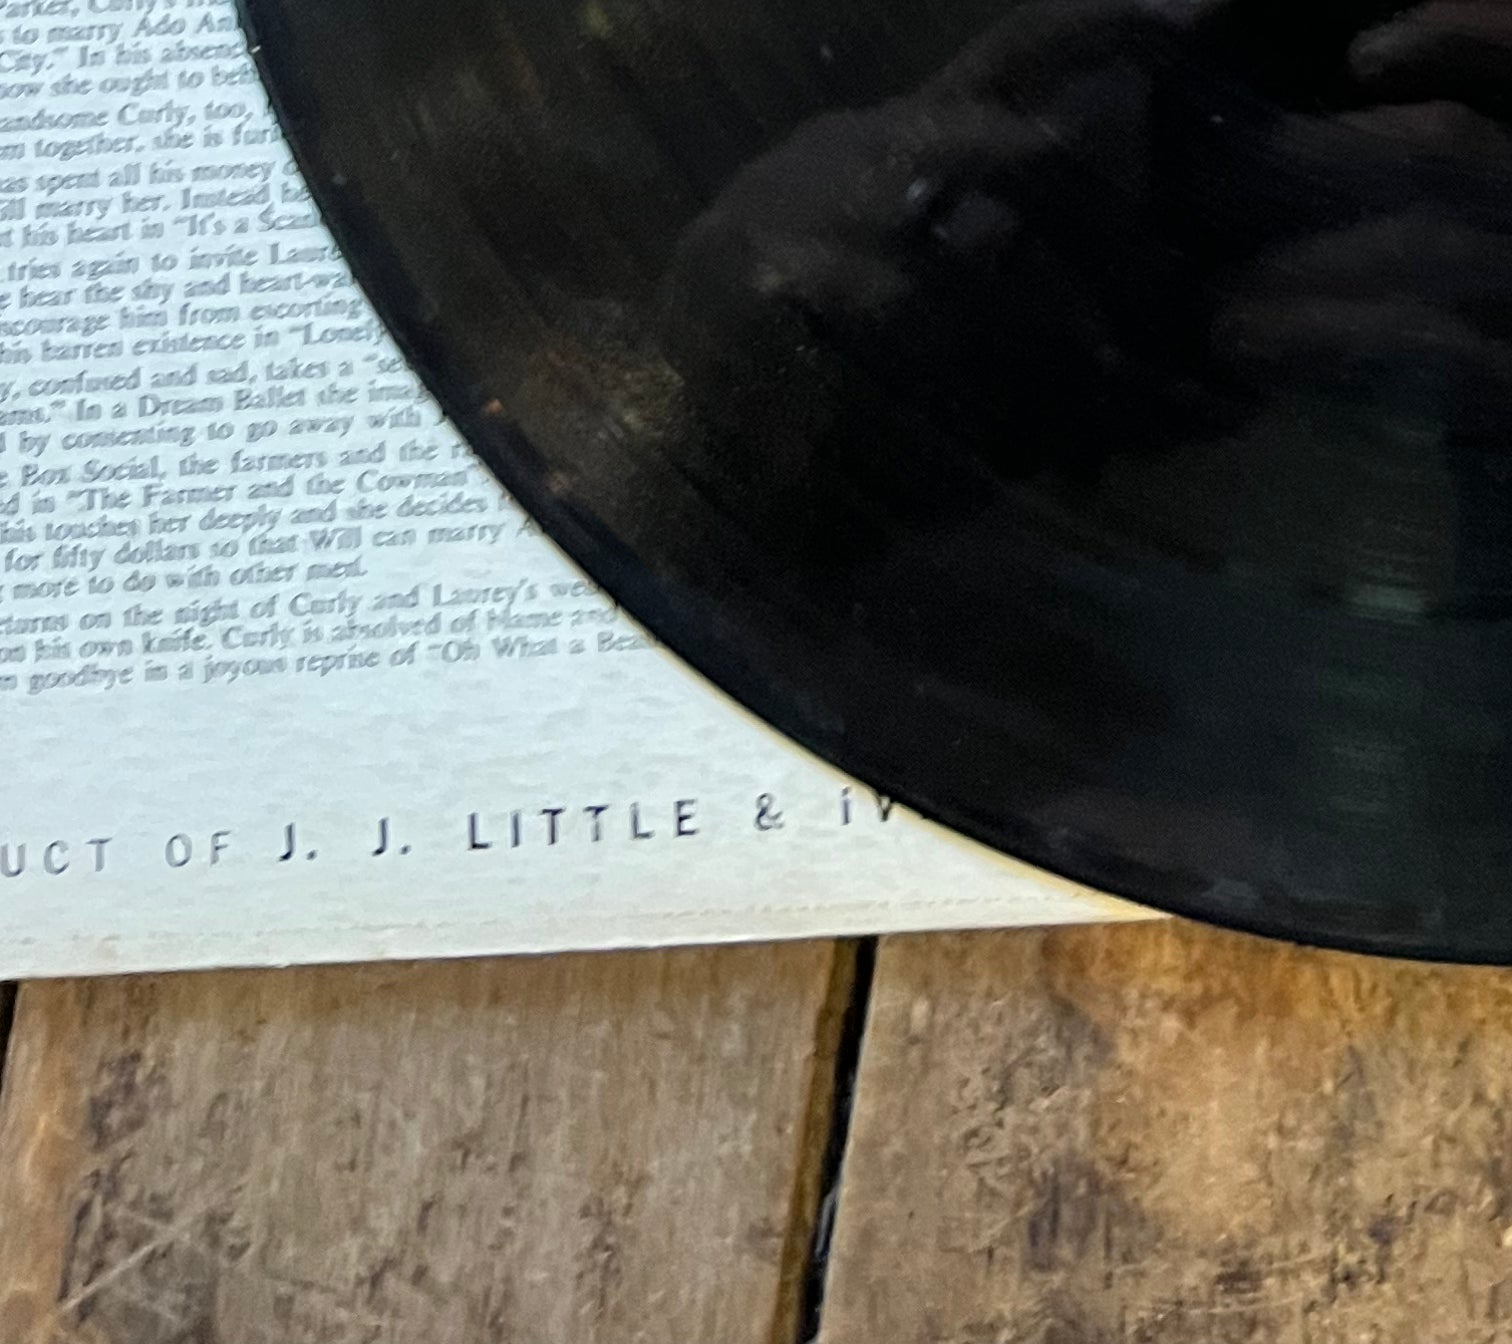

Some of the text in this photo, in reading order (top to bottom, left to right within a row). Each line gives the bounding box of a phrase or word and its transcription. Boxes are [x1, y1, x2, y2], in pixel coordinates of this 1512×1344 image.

[12, 13, 186, 45] to marry Ado
[153, 124, 195, 150] she
[203, 124, 224, 146] is
[4, 523, 506, 572] for fifty dollars so that Will can marry
[13, 577, 80, 600] more
[88, 575, 115, 595] to
[123, 570, 157, 592] do
[165, 564, 221, 589] with
[229, 559, 298, 585] other
[79, 612, 112, 631] on
[123, 603, 164, 627] the
[174, 597, 240, 627] night
[250, 593, 280, 619] of
[289, 589, 362, 617] Curly
[372, 583, 420, 610] and
[35, 635, 71, 663] his
[79, 639, 134, 657] own
[221, 620, 295, 650] Curly
[302, 619, 323, 644] is
[331, 611, 442, 641] absolved
[450, 608, 479, 634] of
[27, 662, 134, 695] goodbye
[145, 659, 168, 682] in
[178, 663, 194, 681] a
[202, 654, 287, 684] joyous
[296, 644, 380, 677] reprise
[390, 641, 419, 667] of
[491, 635, 559, 658] What
[165, 829, 234, 868] OF
[279, 822, 318, 862] J.
[372, 816, 412, 857] J.
[466, 798, 700, 852] LITTLE
[754, 793, 785, 831] &
